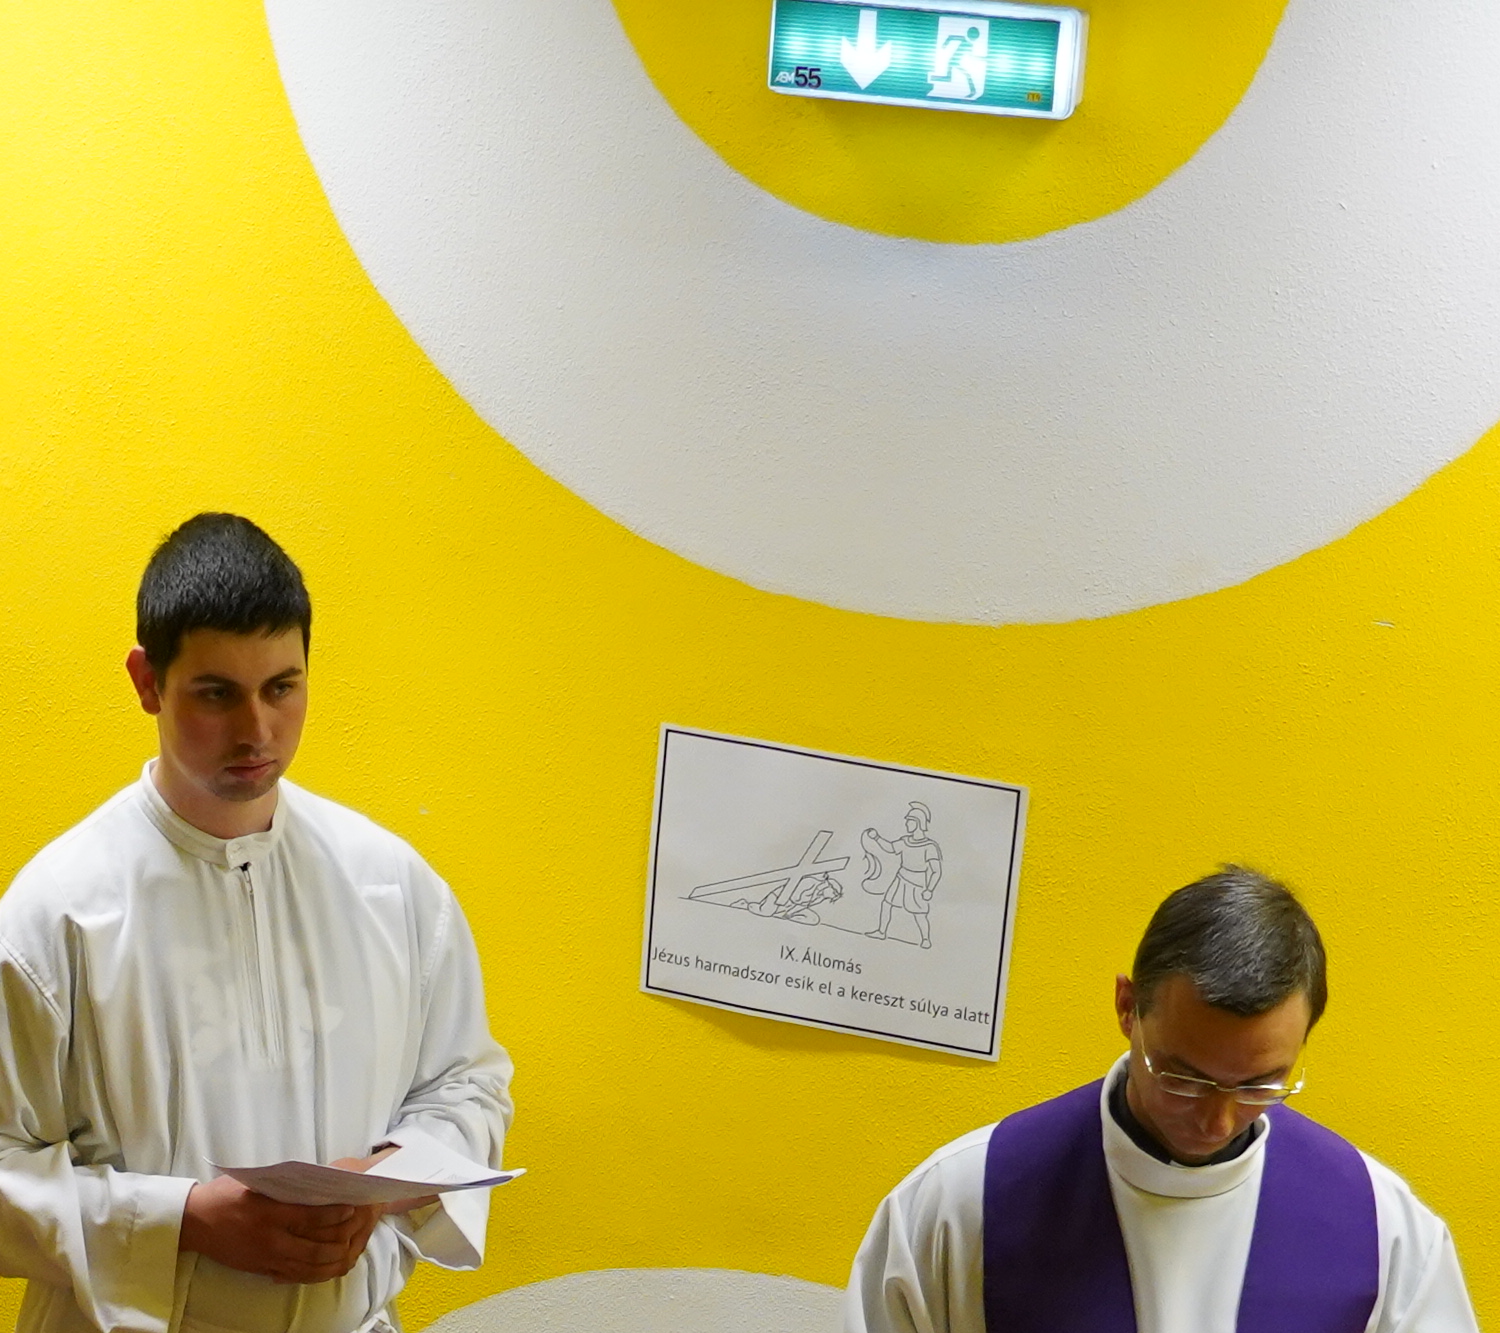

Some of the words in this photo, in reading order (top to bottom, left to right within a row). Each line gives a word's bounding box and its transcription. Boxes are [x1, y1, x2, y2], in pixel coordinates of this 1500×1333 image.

[795, 66, 822, 89] 55
[780, 945, 799, 963] IX.
[801, 946, 863, 975] Állomás
[651, 946, 691, 968] Jézus
[694, 955, 782, 986] harmadszor
[784, 975, 815, 992] esik
[818, 980, 832, 996] el
[836, 986, 846, 998] a
[850, 985, 905, 1010] kereszt
[909, 997, 950, 1019] súlya
[953, 1005, 991, 1025] alatt
